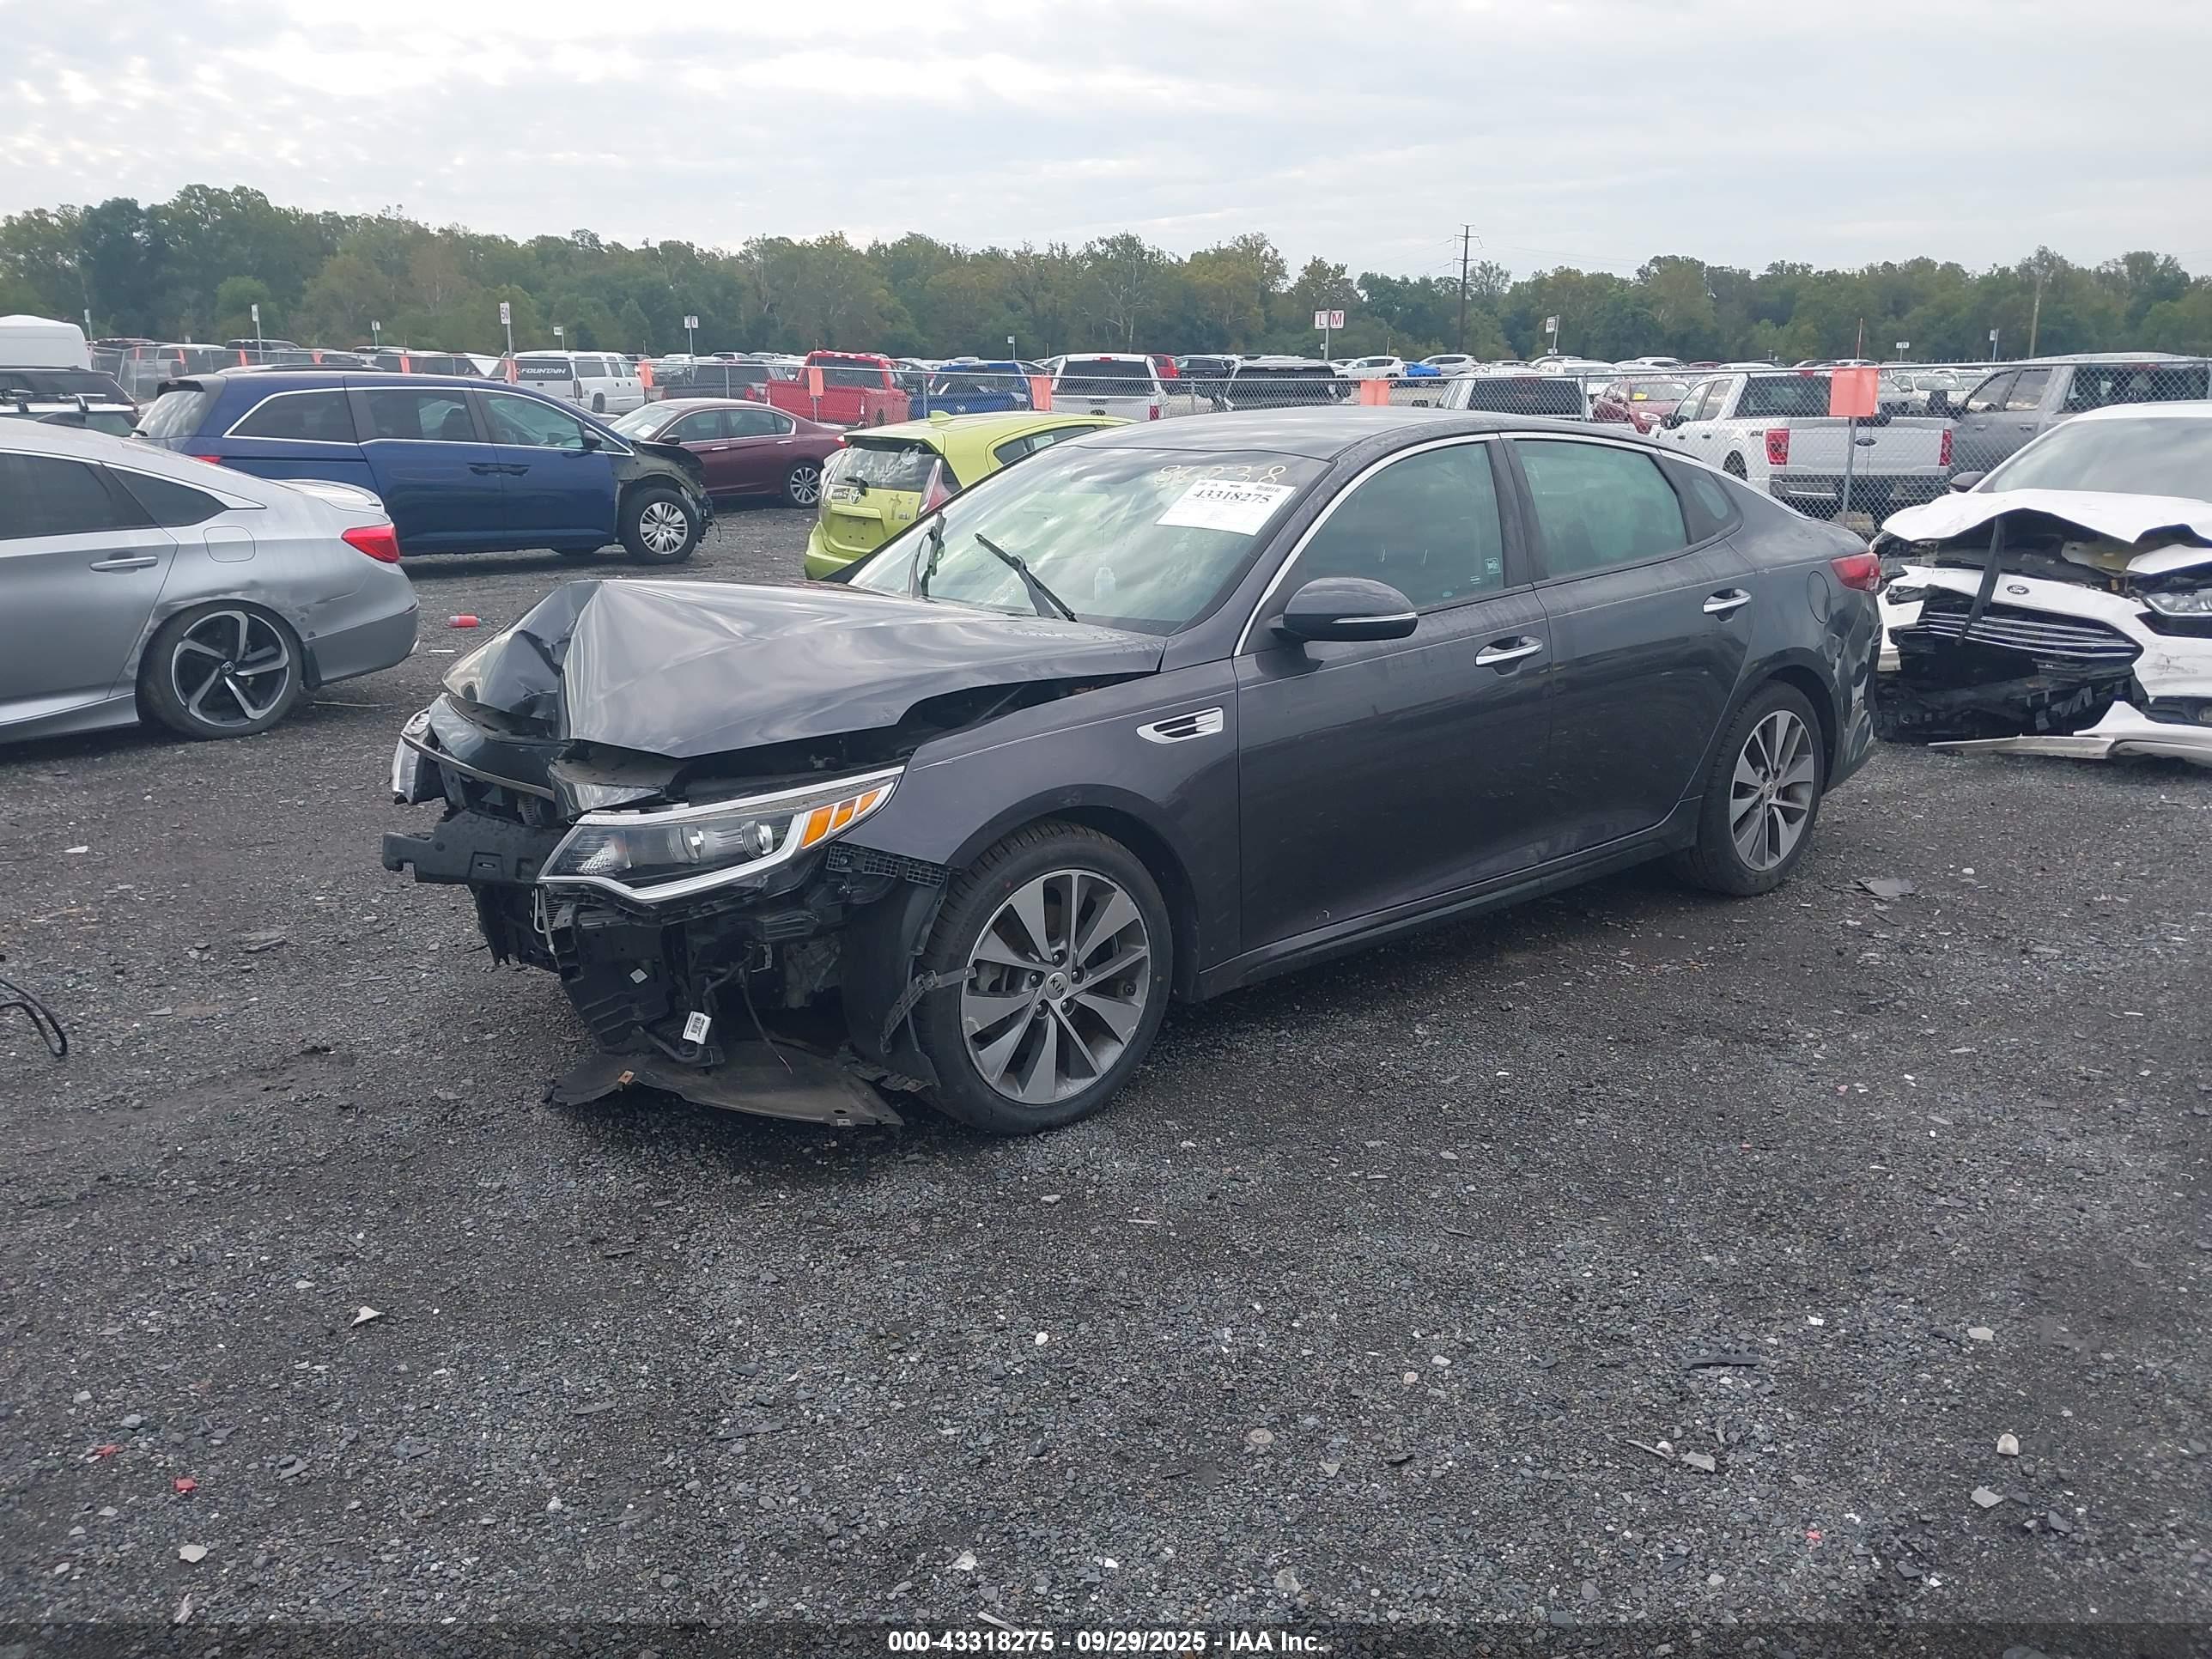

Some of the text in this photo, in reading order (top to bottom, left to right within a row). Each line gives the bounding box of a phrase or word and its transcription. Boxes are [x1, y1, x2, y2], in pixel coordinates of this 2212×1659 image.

[501, 307, 509, 319] 50
[1319, 313, 1342, 325] L M
[1194, 489, 1273, 504] 43318275
[1050, 977, 1065, 997] KIA
